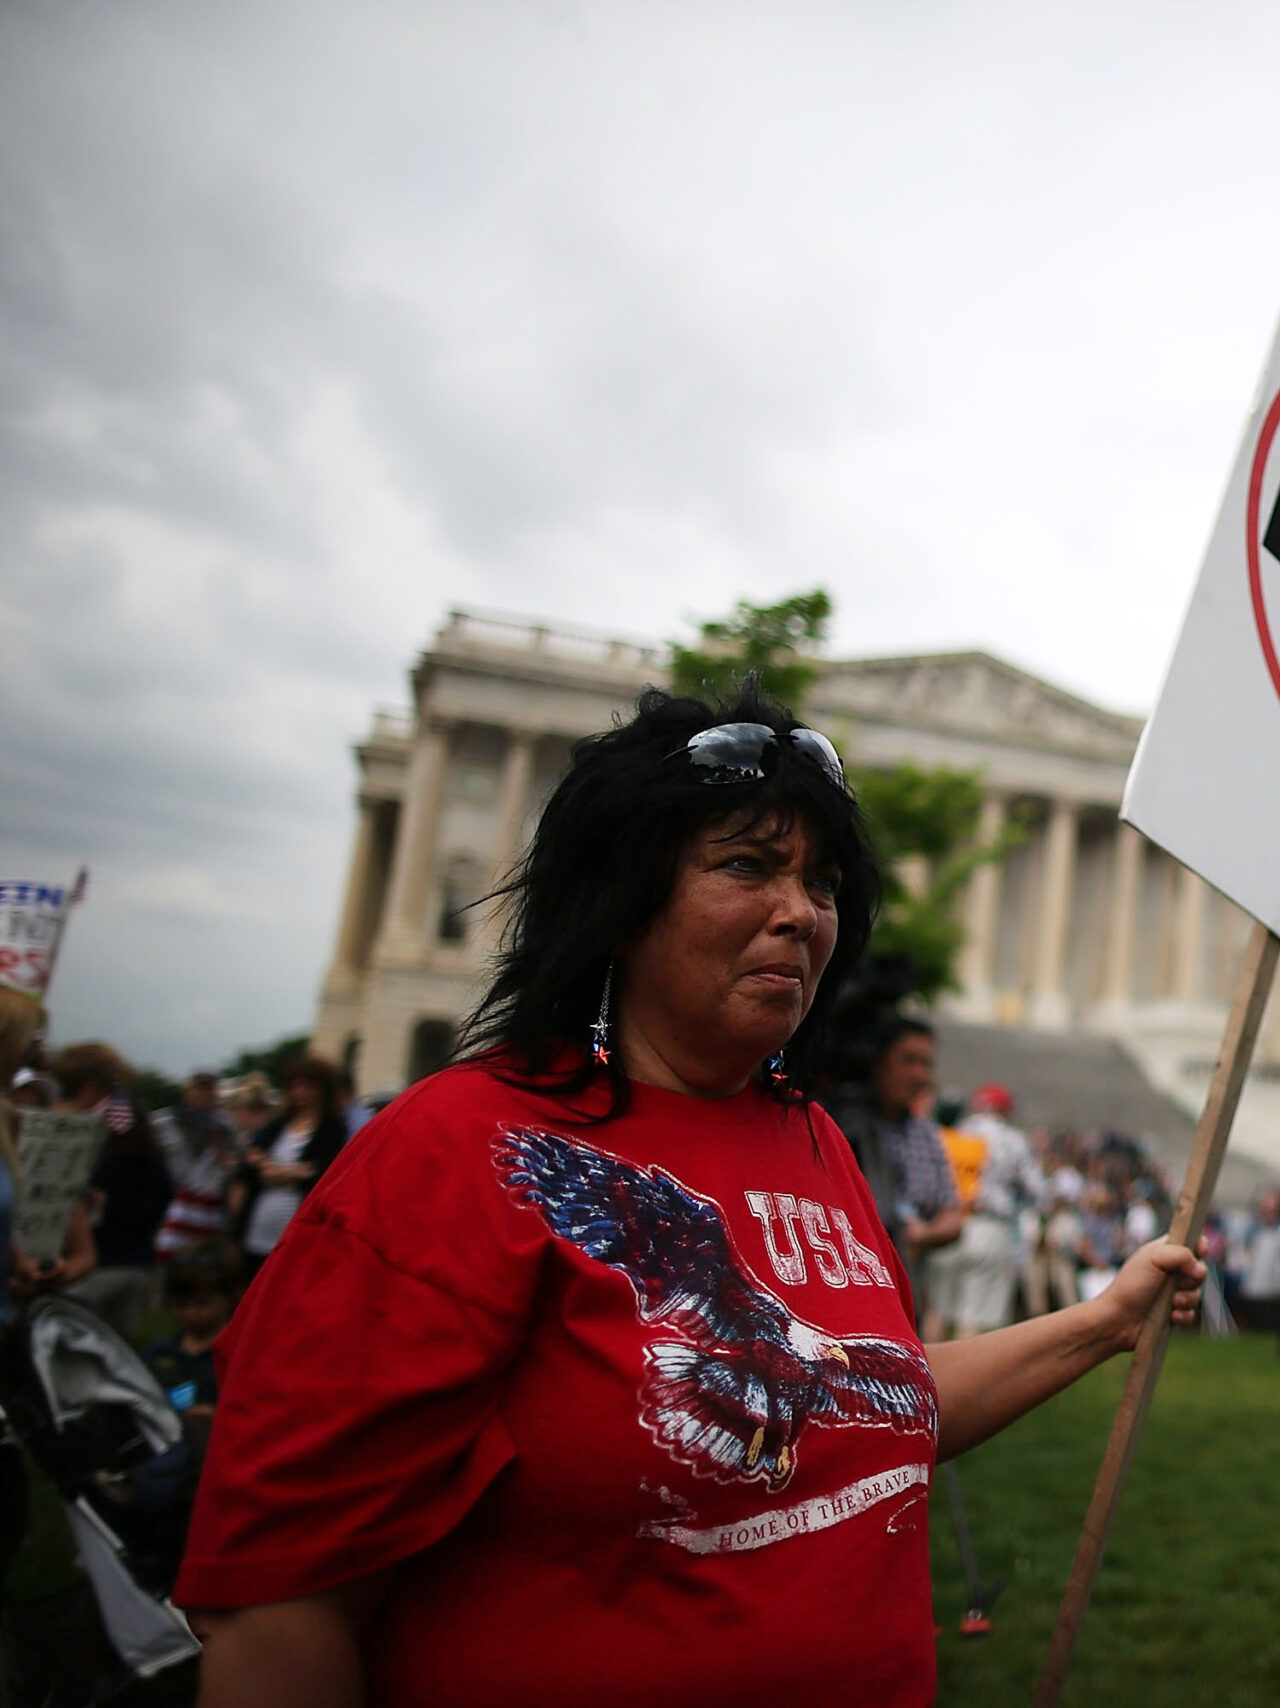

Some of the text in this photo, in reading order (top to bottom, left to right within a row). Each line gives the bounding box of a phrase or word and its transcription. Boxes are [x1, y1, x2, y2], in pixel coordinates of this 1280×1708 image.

[744, 1190, 896, 1289] USA
[719, 1470, 910, 1548] HOME OF THE BRAVE
